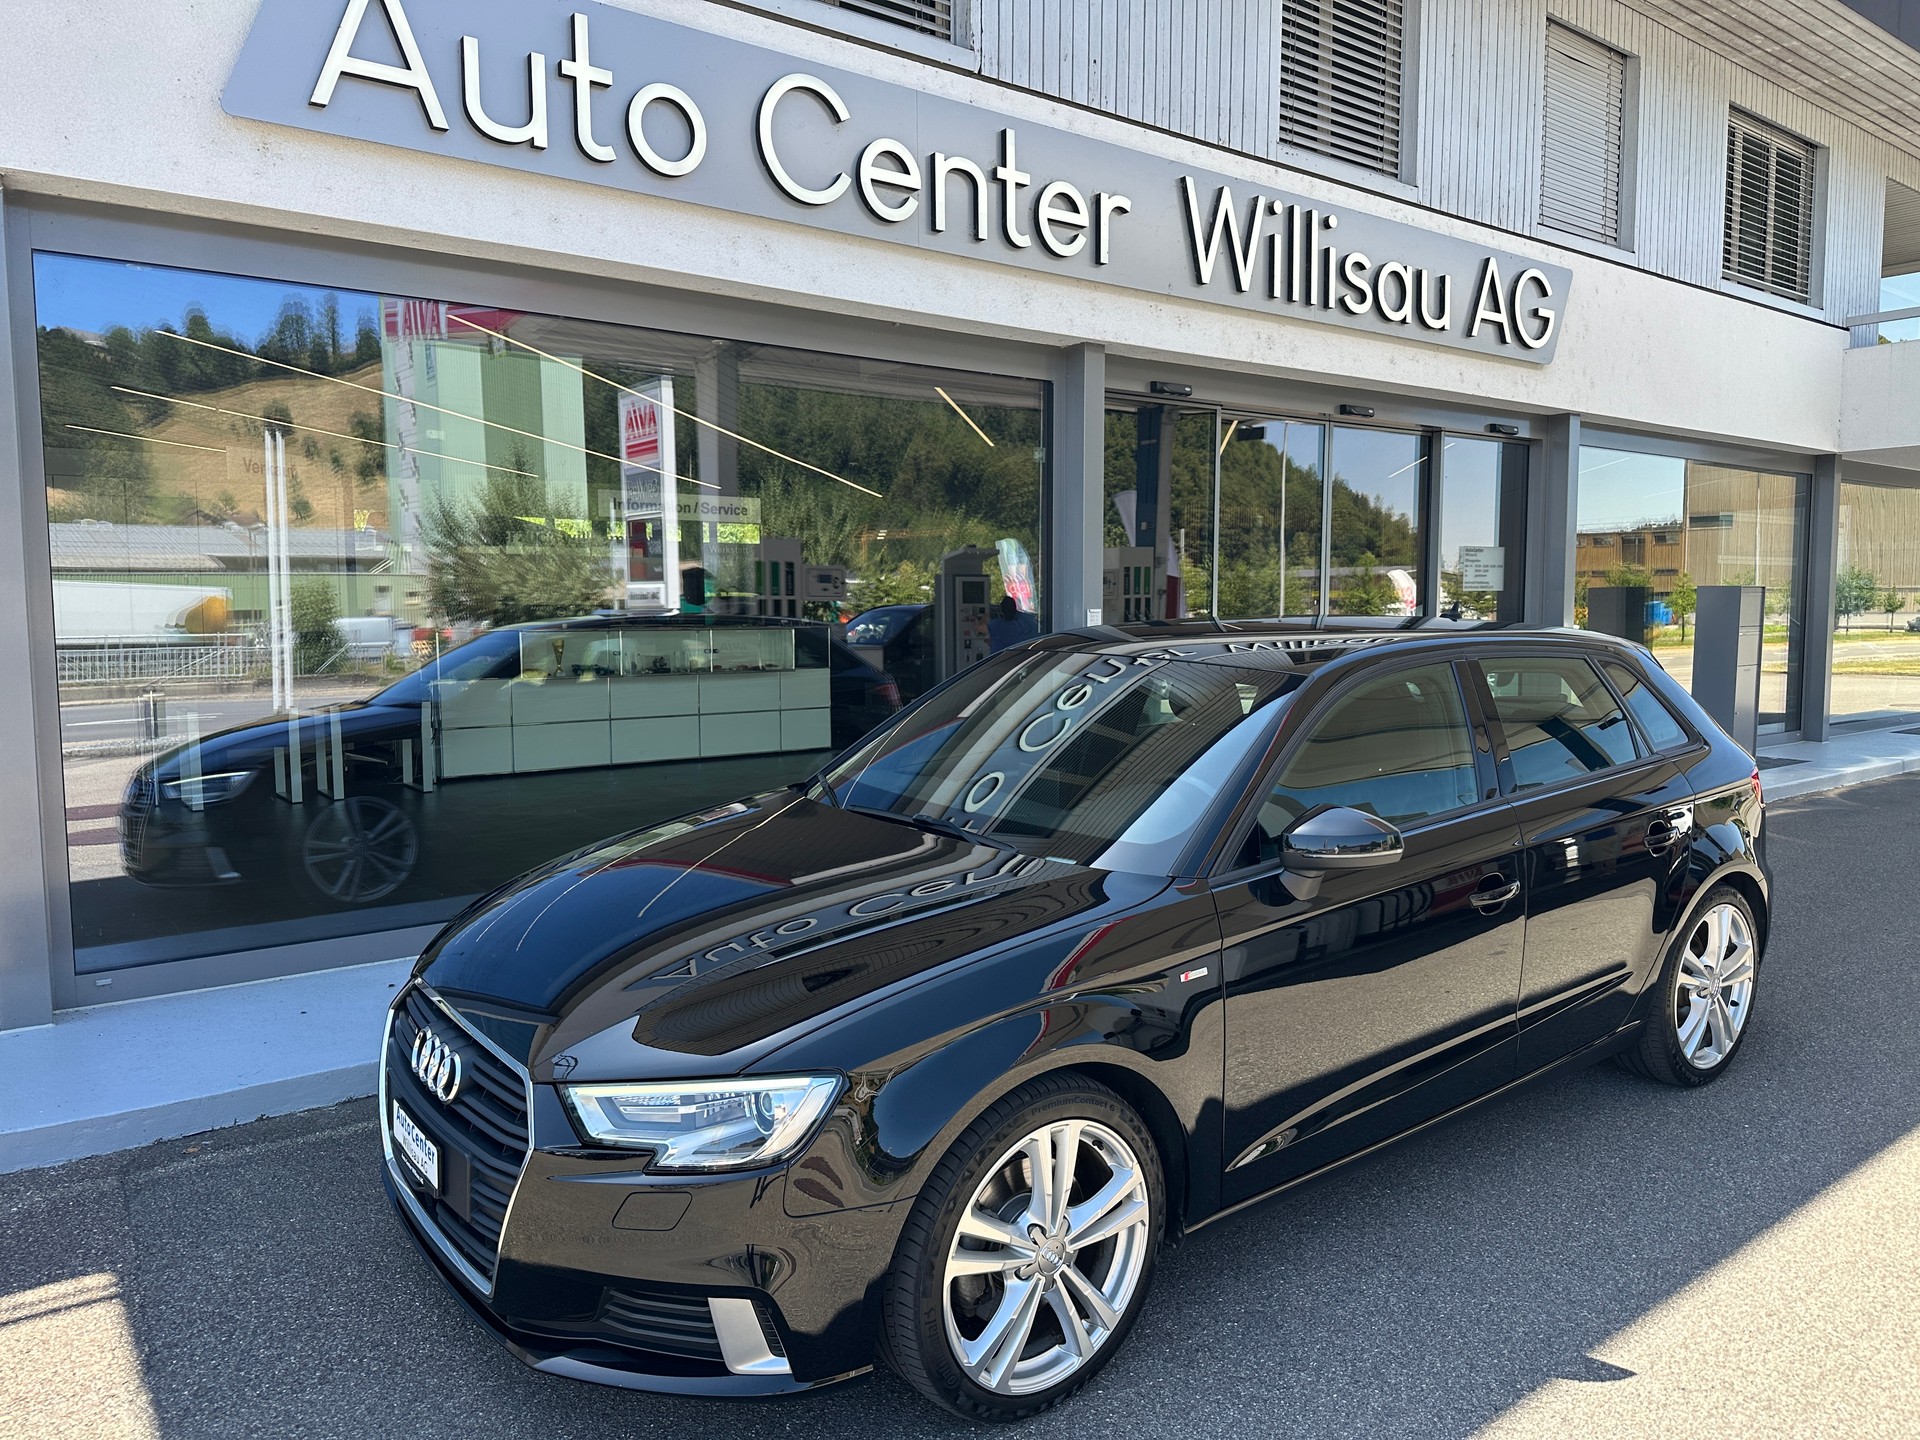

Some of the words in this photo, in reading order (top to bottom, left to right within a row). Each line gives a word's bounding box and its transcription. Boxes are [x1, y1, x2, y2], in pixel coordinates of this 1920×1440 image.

[308, 0, 707, 178] Auto
[756, 73, 1131, 265] Center
[1180, 175, 1452, 331] Willisau
[1466, 256, 1556, 350] AG
[613, 497, 691, 515] Informaon
[701, 502, 748, 516] Service
[1030, 1096, 1108, 1117] PremiumContact
[1109, 1103, 1116, 1112] 6
